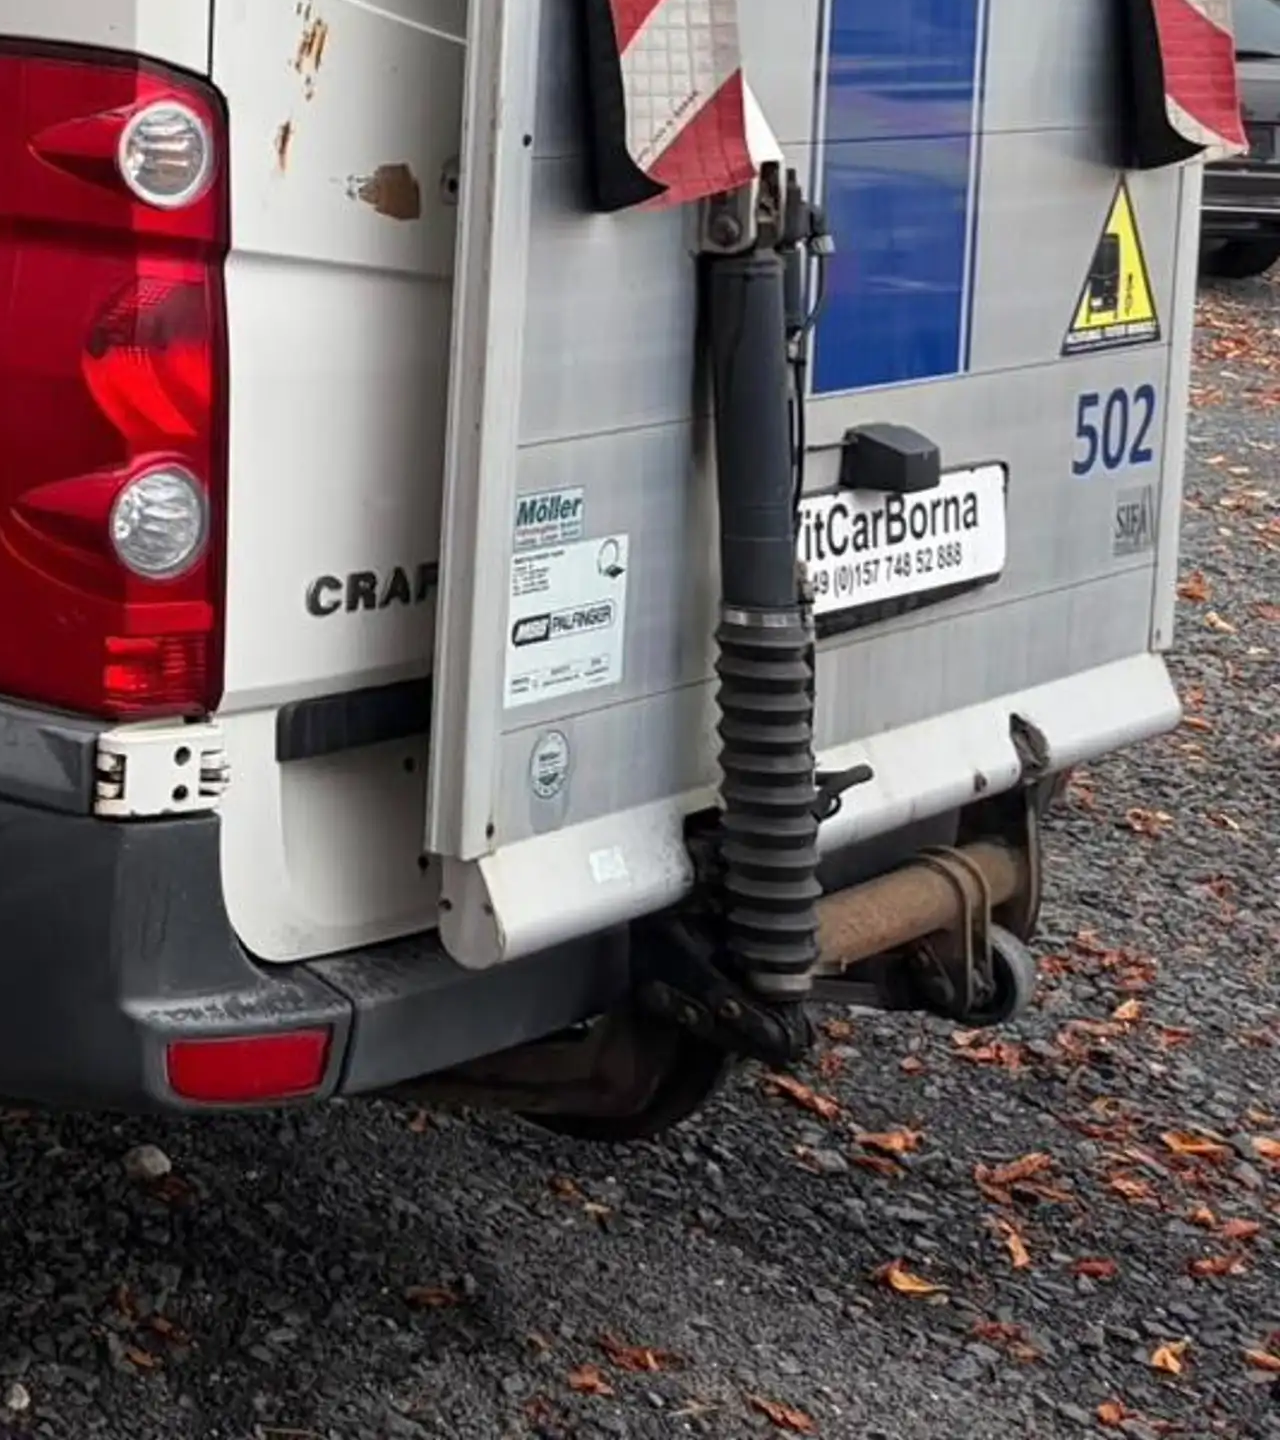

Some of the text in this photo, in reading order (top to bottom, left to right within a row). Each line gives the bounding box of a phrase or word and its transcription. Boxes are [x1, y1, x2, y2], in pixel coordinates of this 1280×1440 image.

[1072, 384, 1155, 475] 502
[516, 494, 583, 526] Möller
[797, 492, 979, 561] itCarBorna
[834, 559, 880, 599] (0)157
[885, 552, 912, 582] 748
[916, 547, 933, 574] 52
[937, 541, 962, 569] 888
